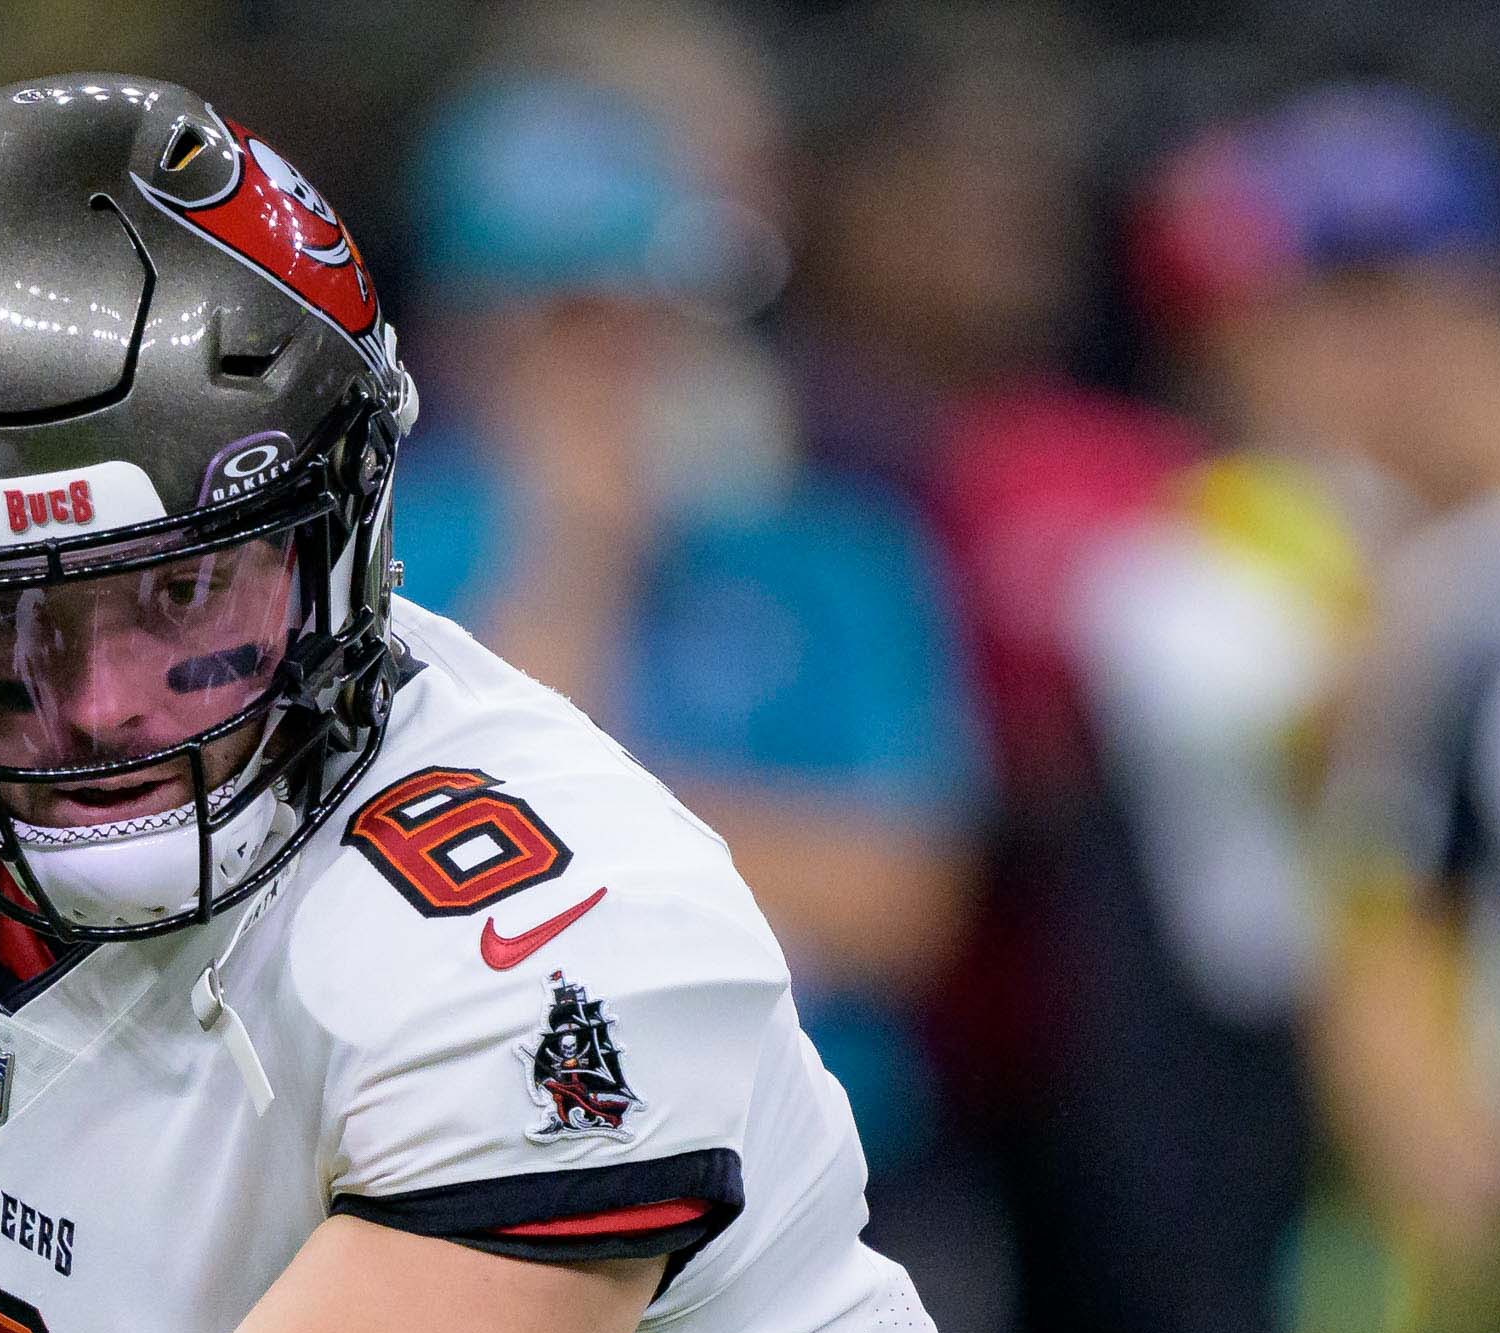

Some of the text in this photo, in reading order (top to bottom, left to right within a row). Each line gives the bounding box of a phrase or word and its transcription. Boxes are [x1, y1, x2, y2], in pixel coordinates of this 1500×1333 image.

[3, 479, 94, 535] BUCS
[212, 459, 291, 502] OAKLEY
[343, 765, 574, 918] 6
